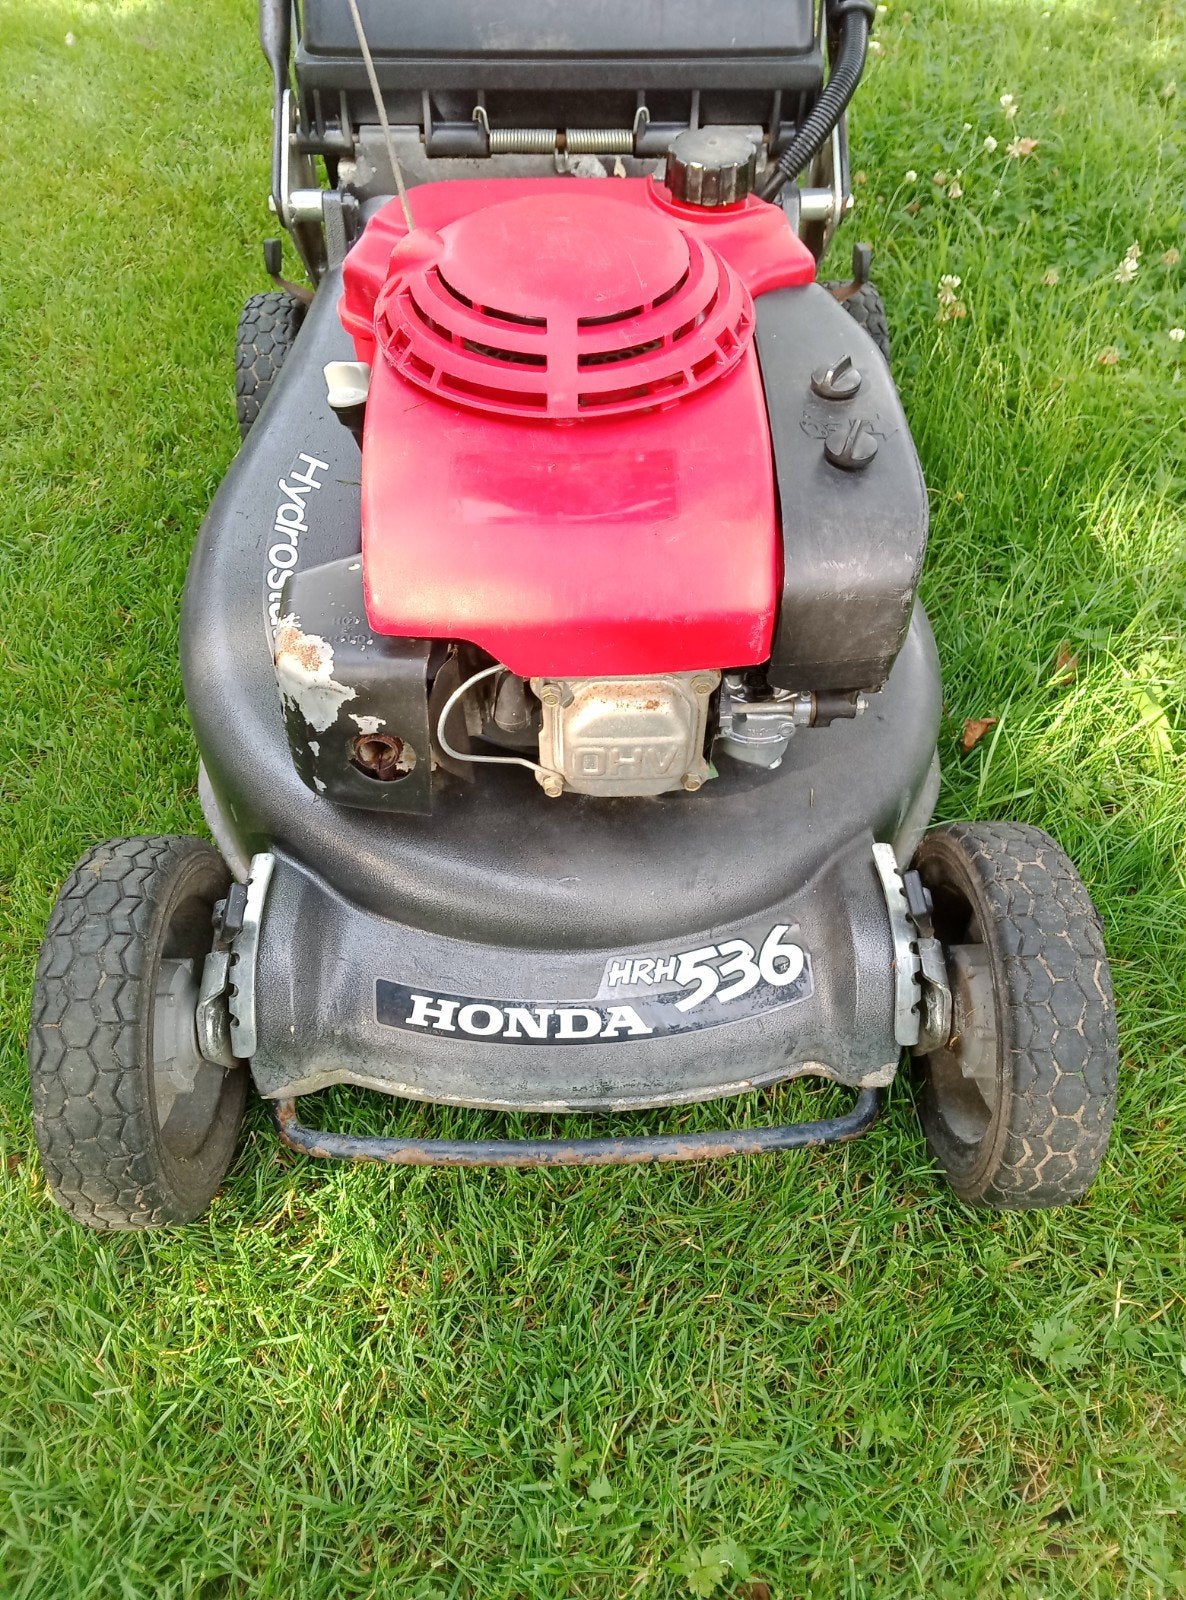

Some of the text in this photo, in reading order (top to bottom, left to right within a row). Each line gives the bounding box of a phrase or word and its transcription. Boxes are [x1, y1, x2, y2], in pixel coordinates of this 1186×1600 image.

[267, 452, 330, 639] Hydros
[572, 746, 679, 776] OHV
[405, 994, 653, 1039] HONDA
